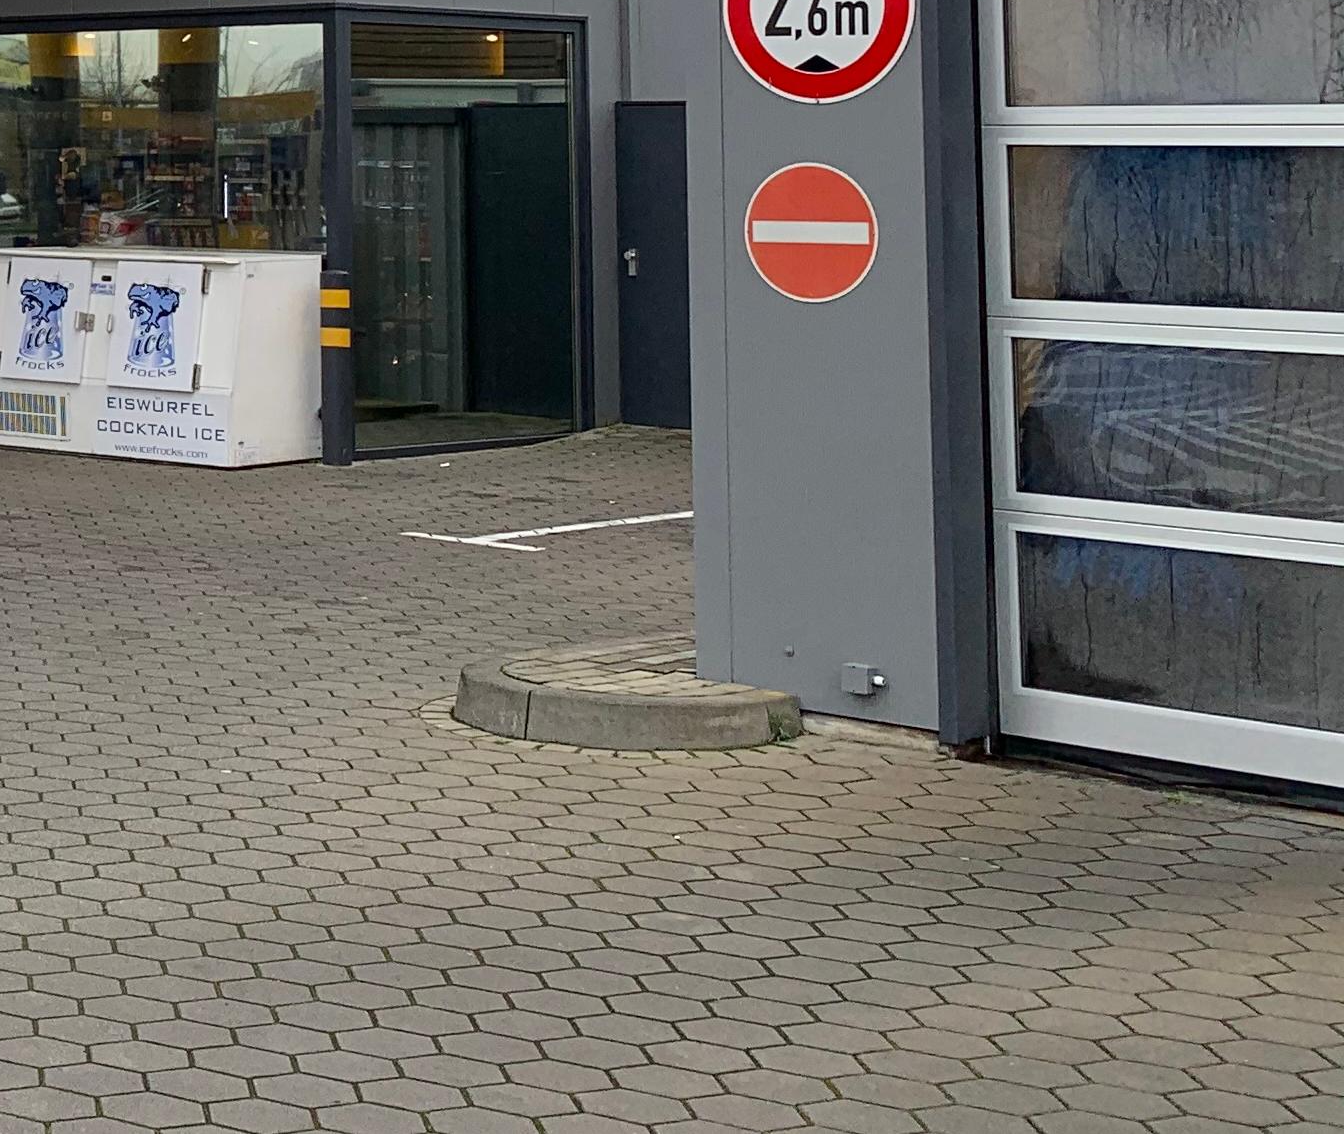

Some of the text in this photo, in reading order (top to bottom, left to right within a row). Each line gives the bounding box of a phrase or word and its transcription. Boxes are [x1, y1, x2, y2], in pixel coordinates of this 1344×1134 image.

[26, 325, 57, 350] ice
[135, 330, 169, 356] ice
[15, 356, 65, 371] frocks
[123, 363, 177, 378] frocks
[106, 396, 215, 417] EISWÜRFEL
[97, 419, 226, 442] COCKTAIL ICE
[114, 443, 208, 459] www.icefrocks.com
